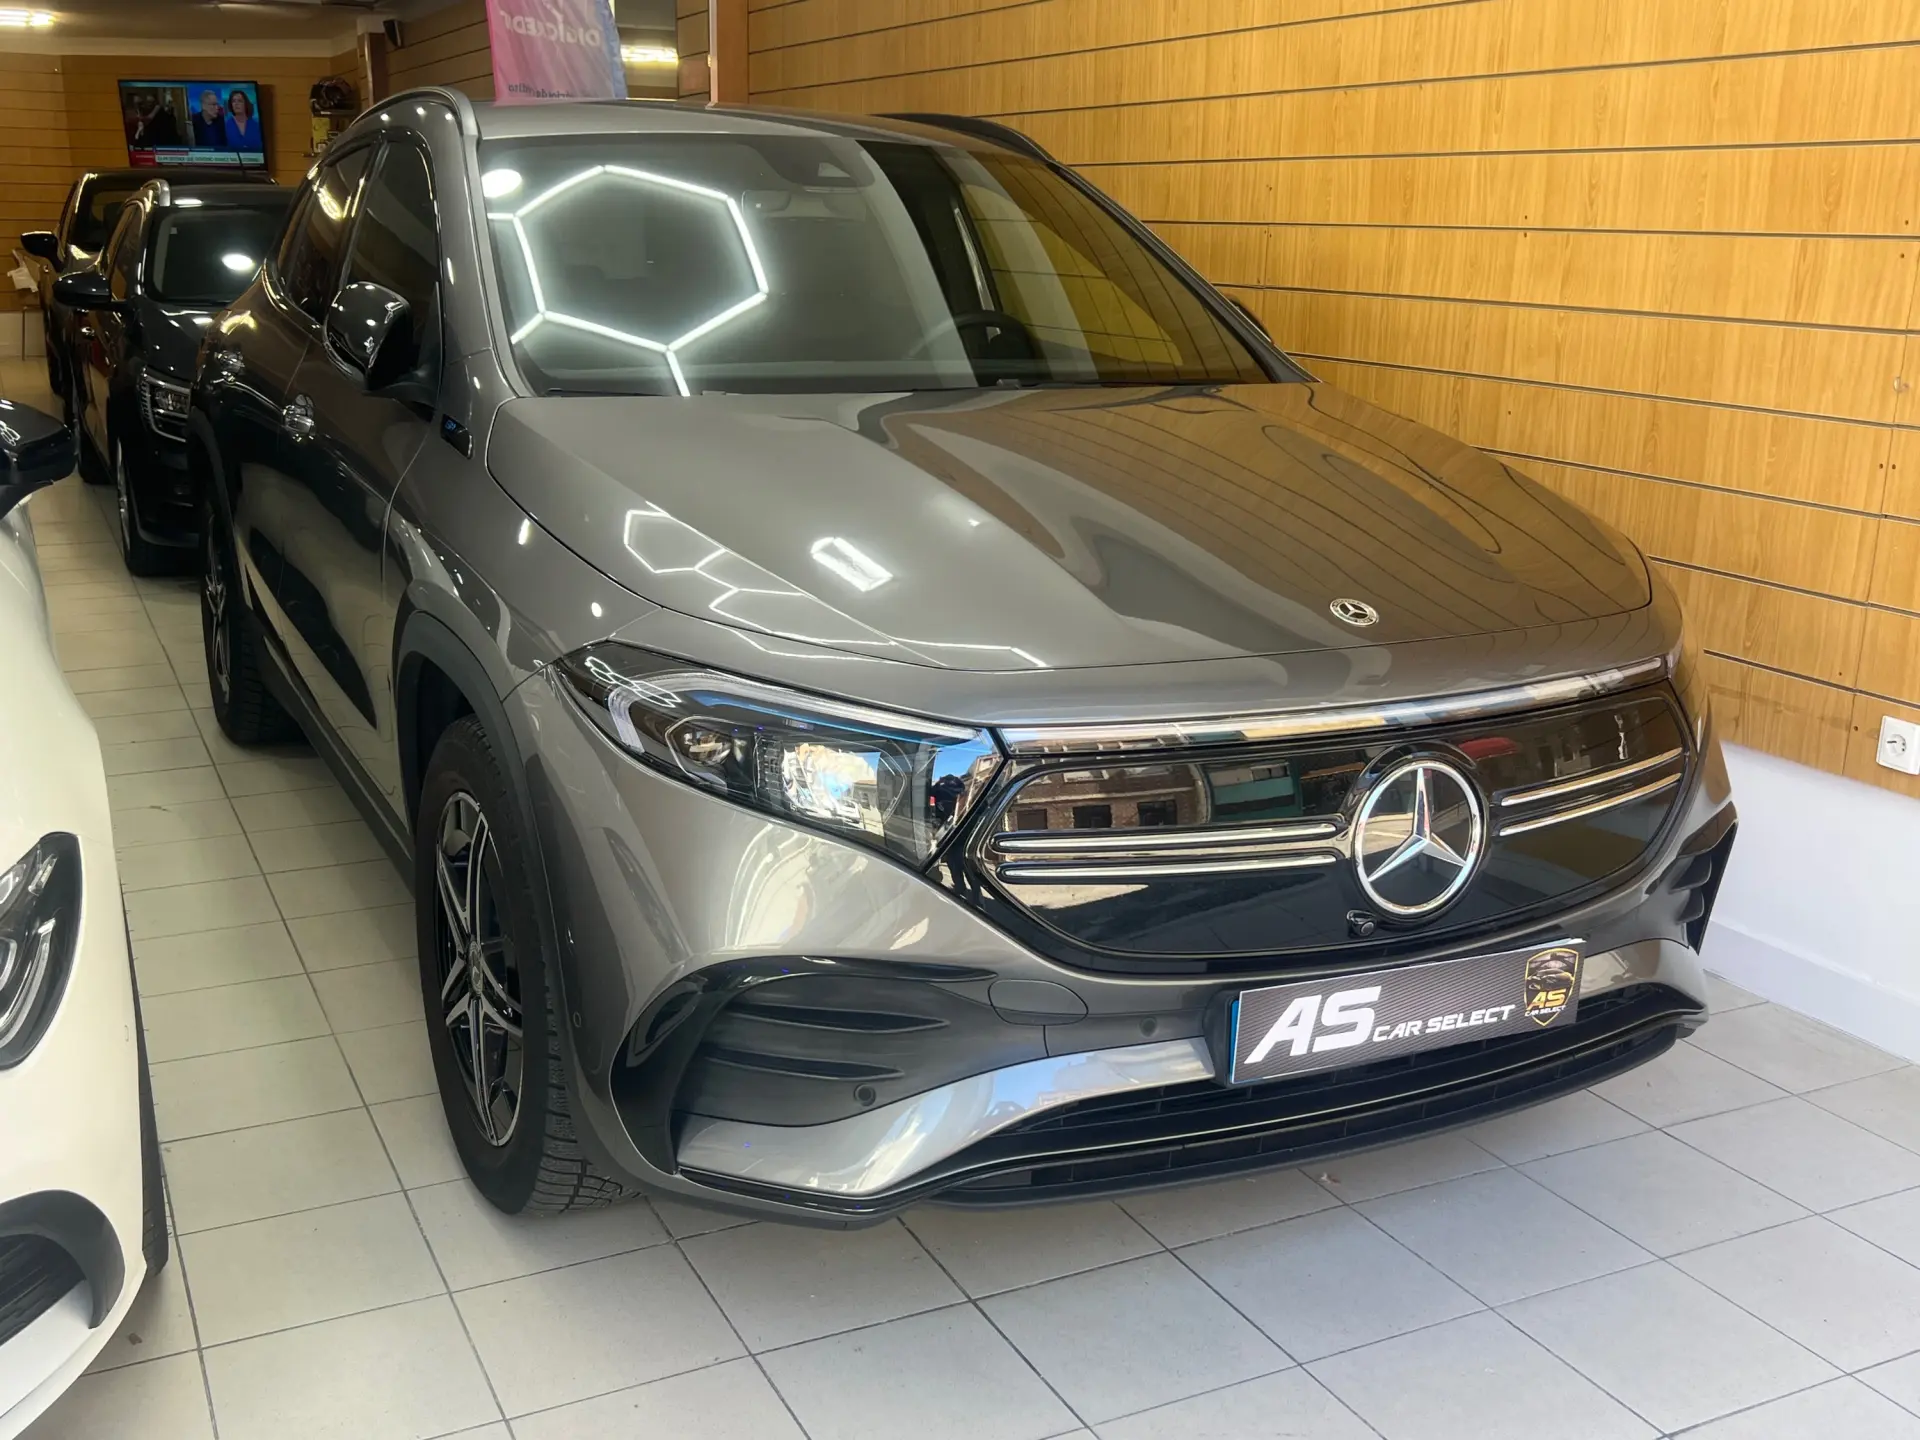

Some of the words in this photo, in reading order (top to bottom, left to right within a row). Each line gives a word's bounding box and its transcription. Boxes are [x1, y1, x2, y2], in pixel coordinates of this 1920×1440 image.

[1526, 988, 1567, 1011] AS
[1539, 1005, 1566, 1014] SELECT
[1243, 985, 1382, 1064] AS
[1372, 1020, 1423, 1042] CAR
[1425, 1004, 1516, 1034] SELECT
